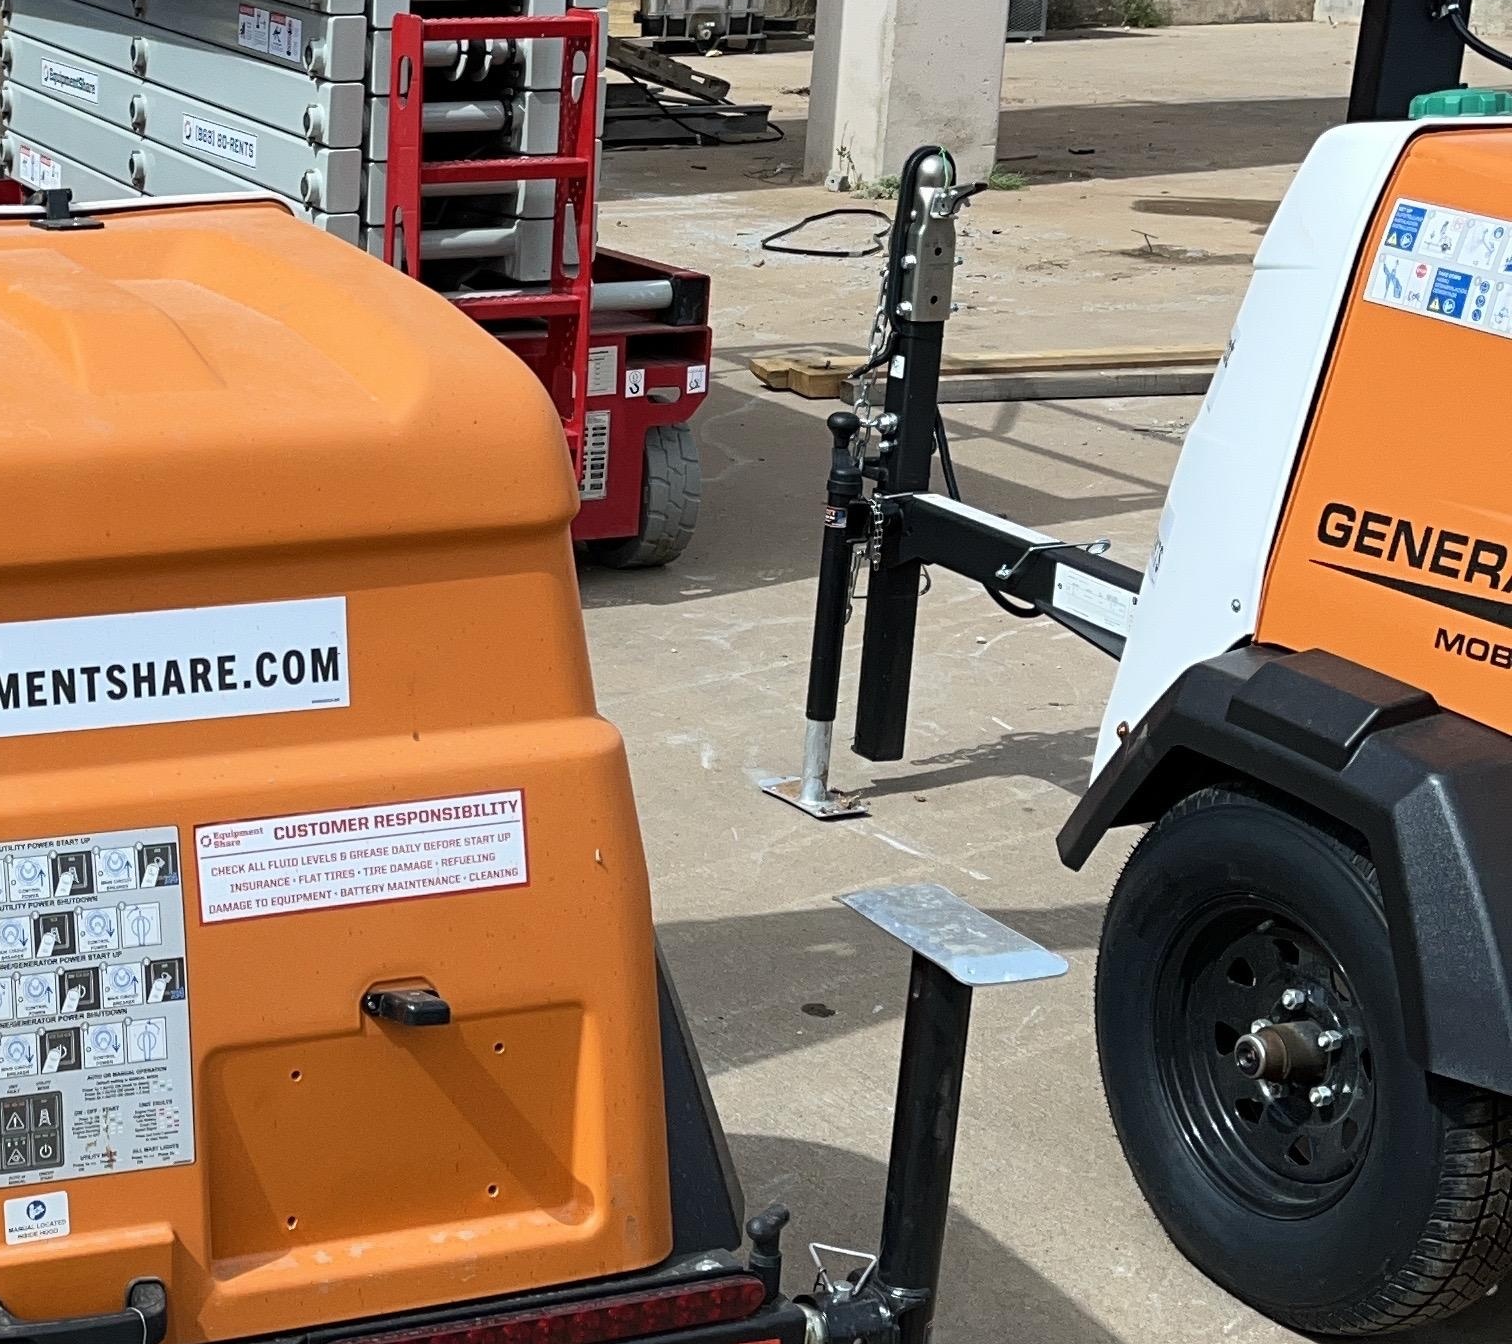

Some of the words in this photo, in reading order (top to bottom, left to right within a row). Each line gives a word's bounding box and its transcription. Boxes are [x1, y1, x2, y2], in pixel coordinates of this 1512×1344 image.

[1317, 502, 1512, 594] GENER
[213, 827, 264, 841] Equipment
[273, 816, 370, 841] CUSTOMER
[373, 799, 519, 829] RESPONSIBILITY
[210, 864, 246, 877] CHECK
[247, 860, 266, 872] ALL
[268, 857, 299, 870] FLUID
[301, 853, 337, 866] LEVELS
[349, 846, 390, 860] GREASE
[391, 842, 421, 855] DAILY
[423, 838, 462, 851] BEFORE
[463, 833, 496, 846] START
[497, 832, 511, 843] UP
[213, 838, 241, 849] Share
[209, 900, 253, 915] DAMAGE
[255, 897, 269, 908] TO
[271, 890, 332, 907] EQUIPMENT
[340, 884, 385, 898] BATTERY
[387, 874, 461, 891] MAINTENANCE
[468, 867, 519, 882] CLEANING
[230, 877, 291, 893] INSURANCE
[298, 872, 322, 885] FLAT
[324, 869, 355, 882] TIRES
[363, 864, 388, 877] TIRE
[390, 860, 433, 873] DAMAGE
[440, 852, 496, 867] REFUELING
